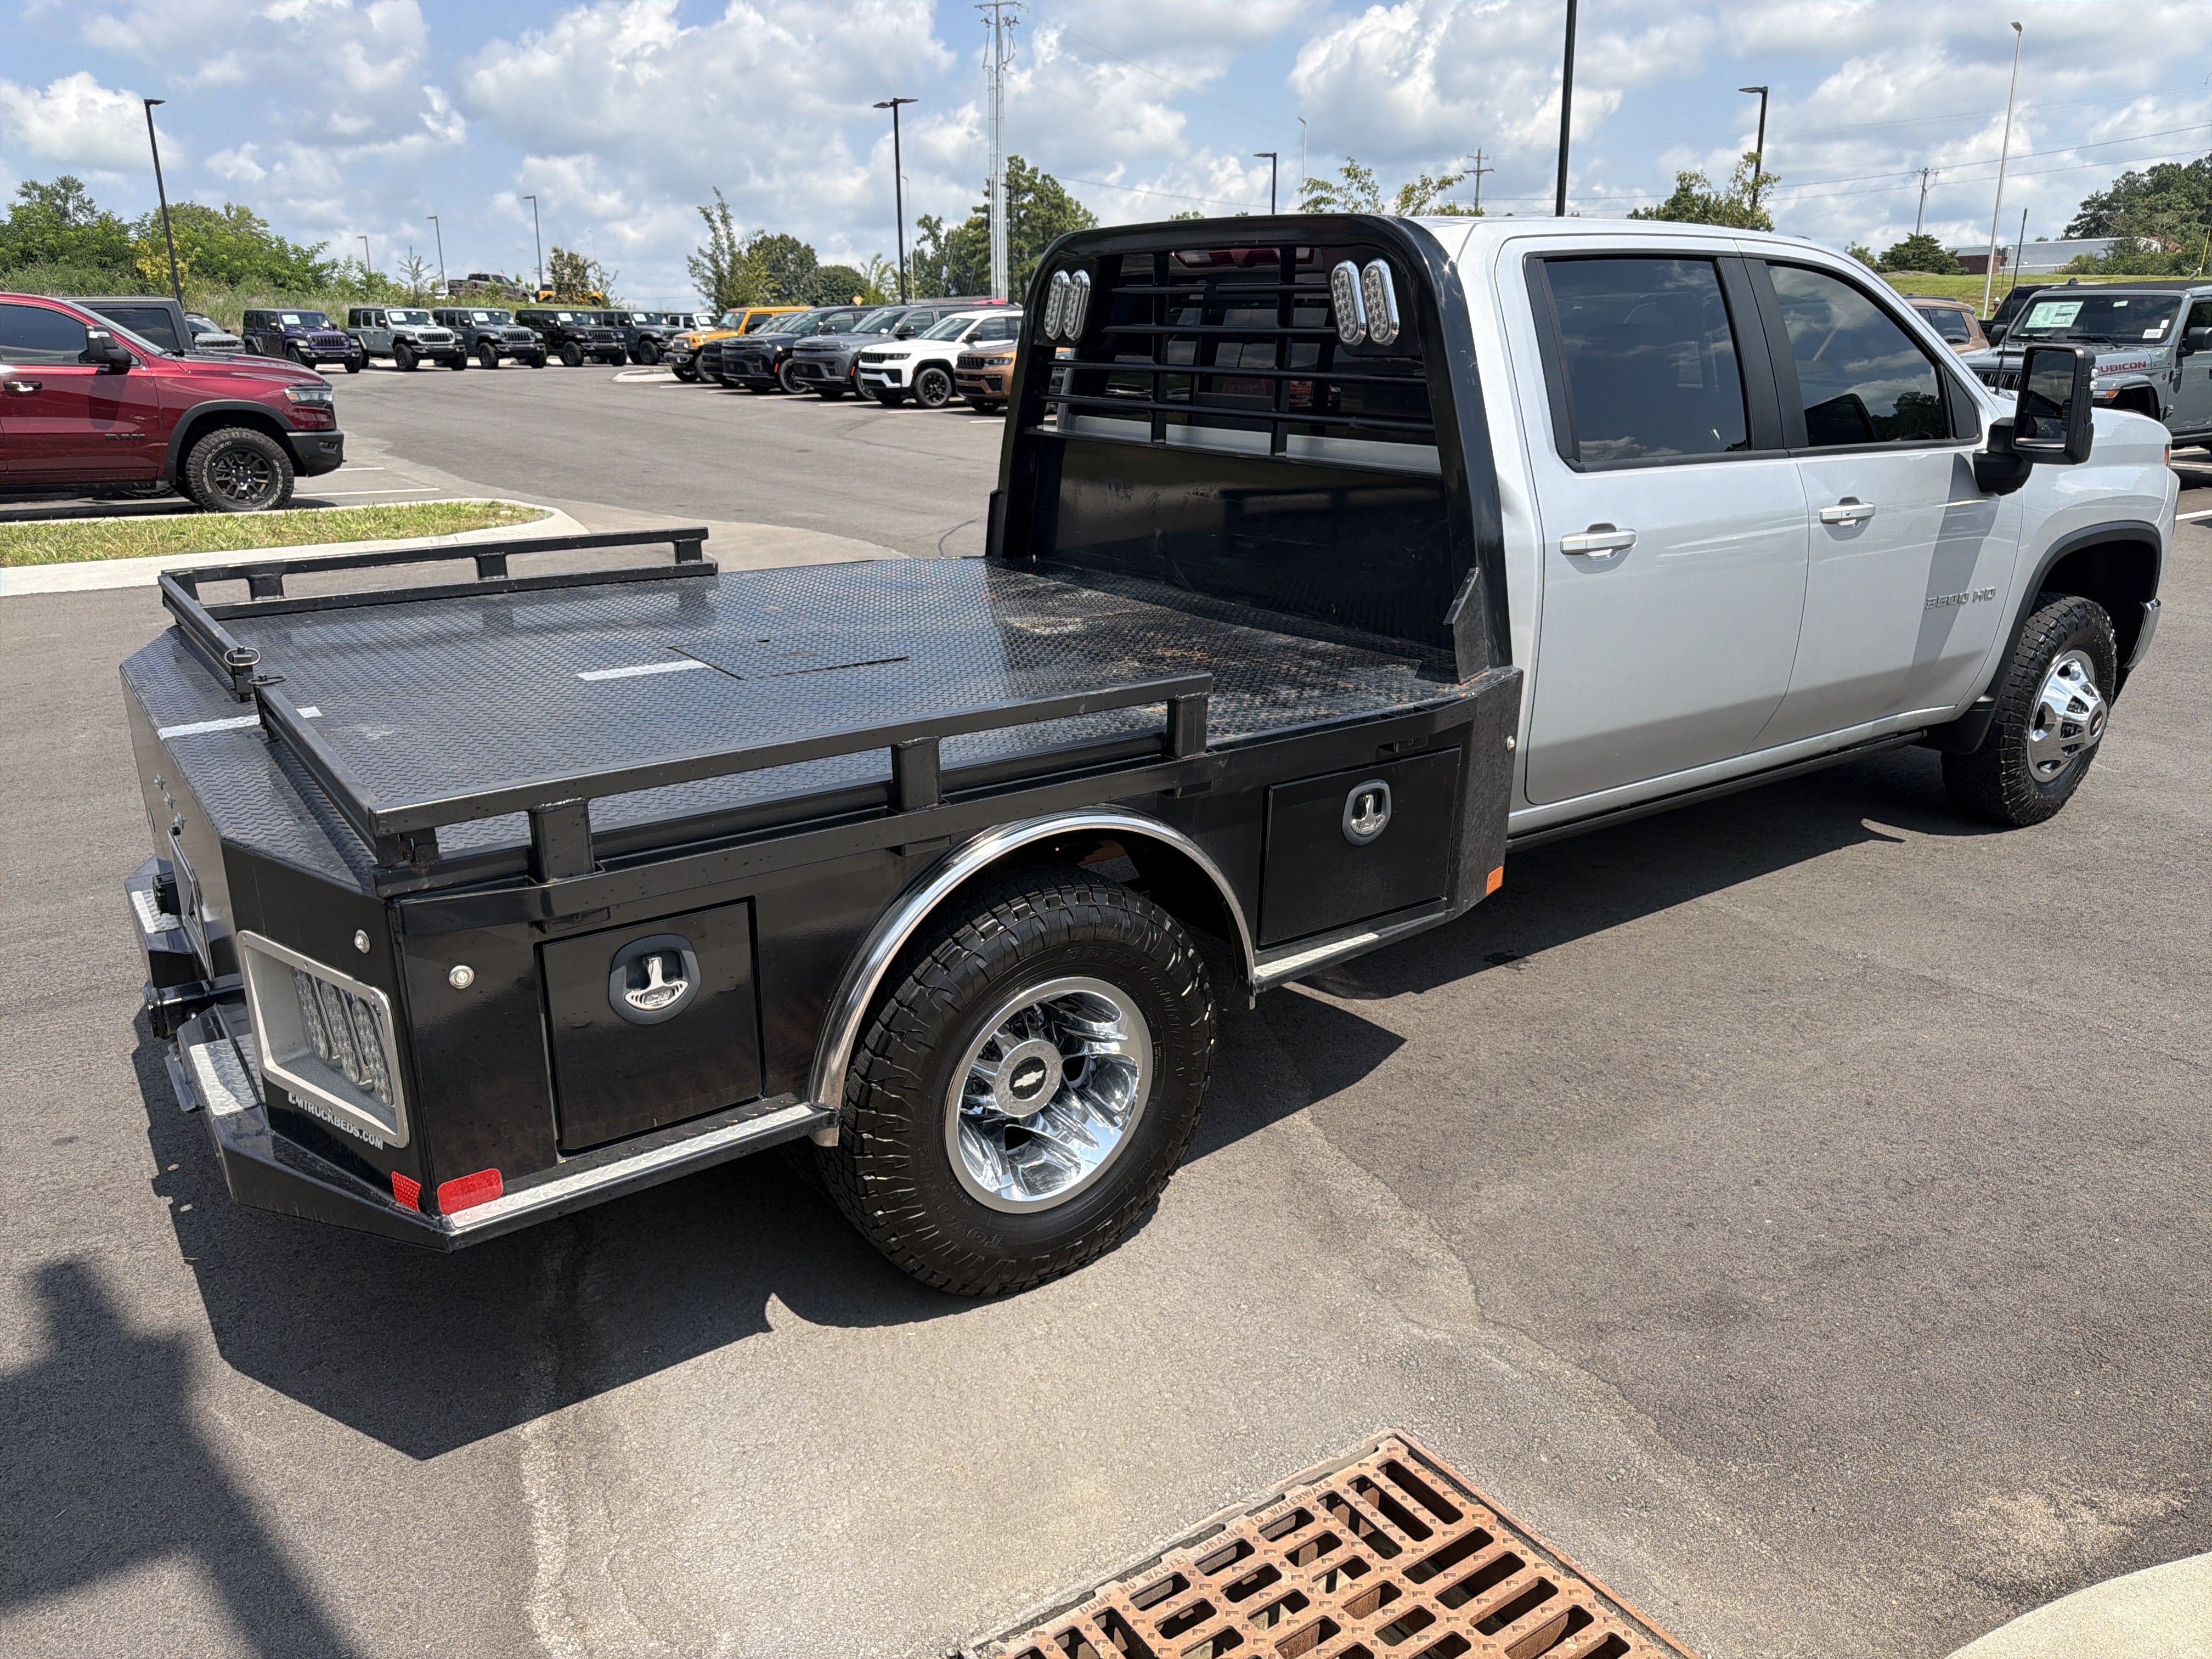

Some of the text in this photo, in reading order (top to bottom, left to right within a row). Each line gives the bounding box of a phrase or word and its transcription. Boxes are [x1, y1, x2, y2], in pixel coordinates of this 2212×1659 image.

[2097, 361, 2146, 373] UBICON
[1926, 587, 1996, 610] 3500 HD
[288, 1092, 383, 1150] CMTRUCKBEDS.COM
[1079, 1593, 1111, 1615] DUMP
[1118, 1580, 1137, 1595] NO
[1199, 1526, 1244, 1553] DRAINS
[1246, 1515, 1264, 1528] TO
[1268, 1480, 1333, 1515] WATERWAYS
